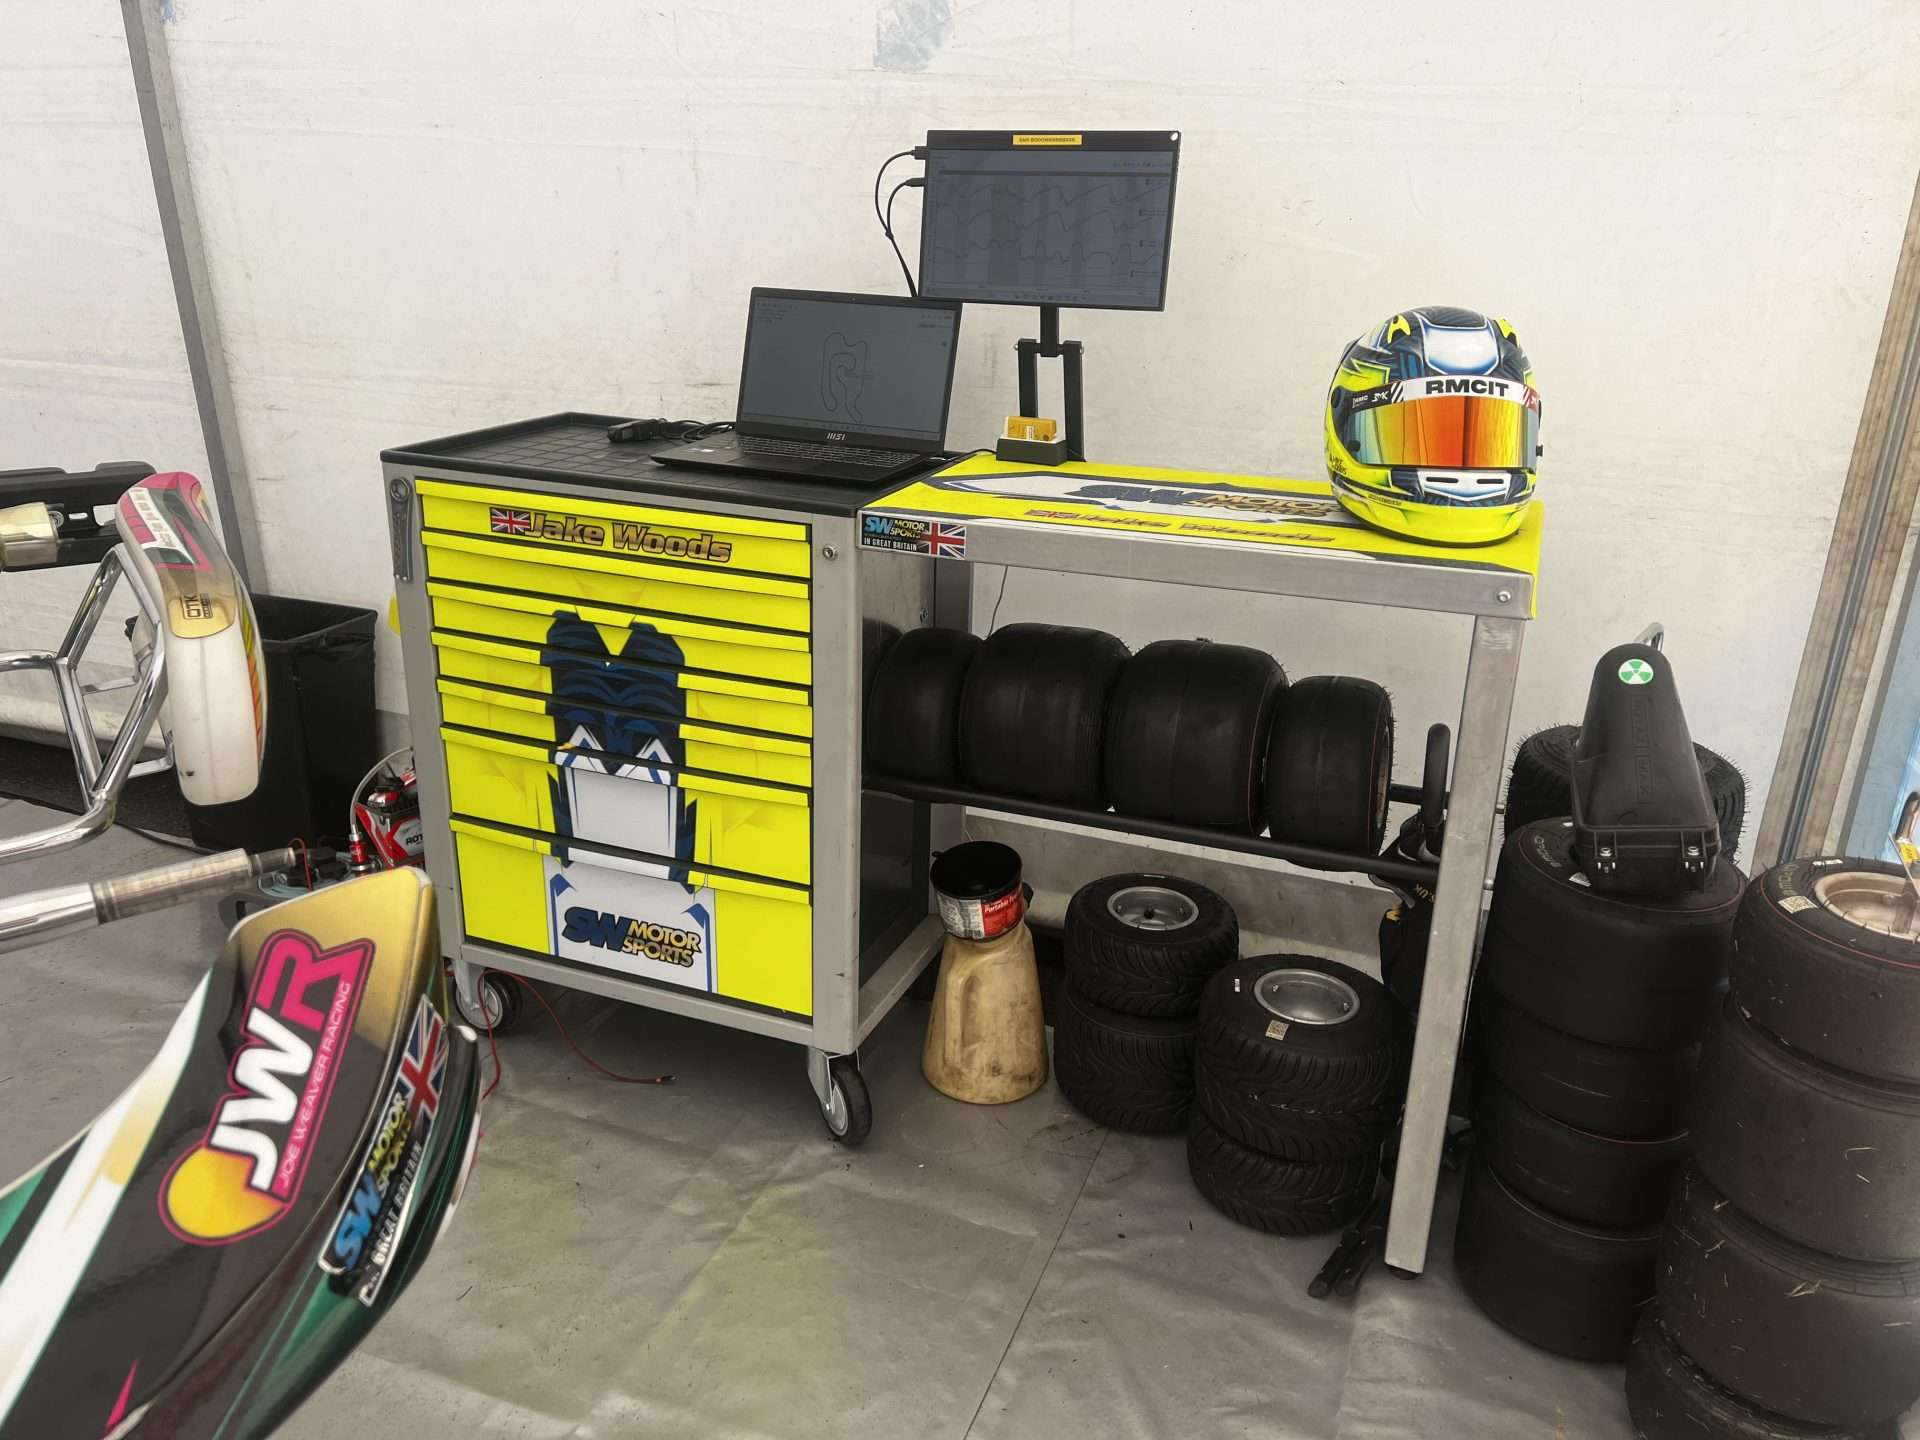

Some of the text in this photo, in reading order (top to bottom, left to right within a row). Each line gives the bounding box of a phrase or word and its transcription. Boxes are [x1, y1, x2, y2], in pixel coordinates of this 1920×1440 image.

[1425, 378, 1510, 397] RMCIT
[524, 512, 733, 563] Jake Woods
[864, 516, 926, 534] SW MOTOR
[873, 539, 891, 549] GREAT
[562, 906, 703, 953] SW MOTOR
[621, 938, 695, 968] SPORTS
[211, 936, 361, 1192] JWR
[282, 980, 352, 1189] JOE WEAVER RACING
